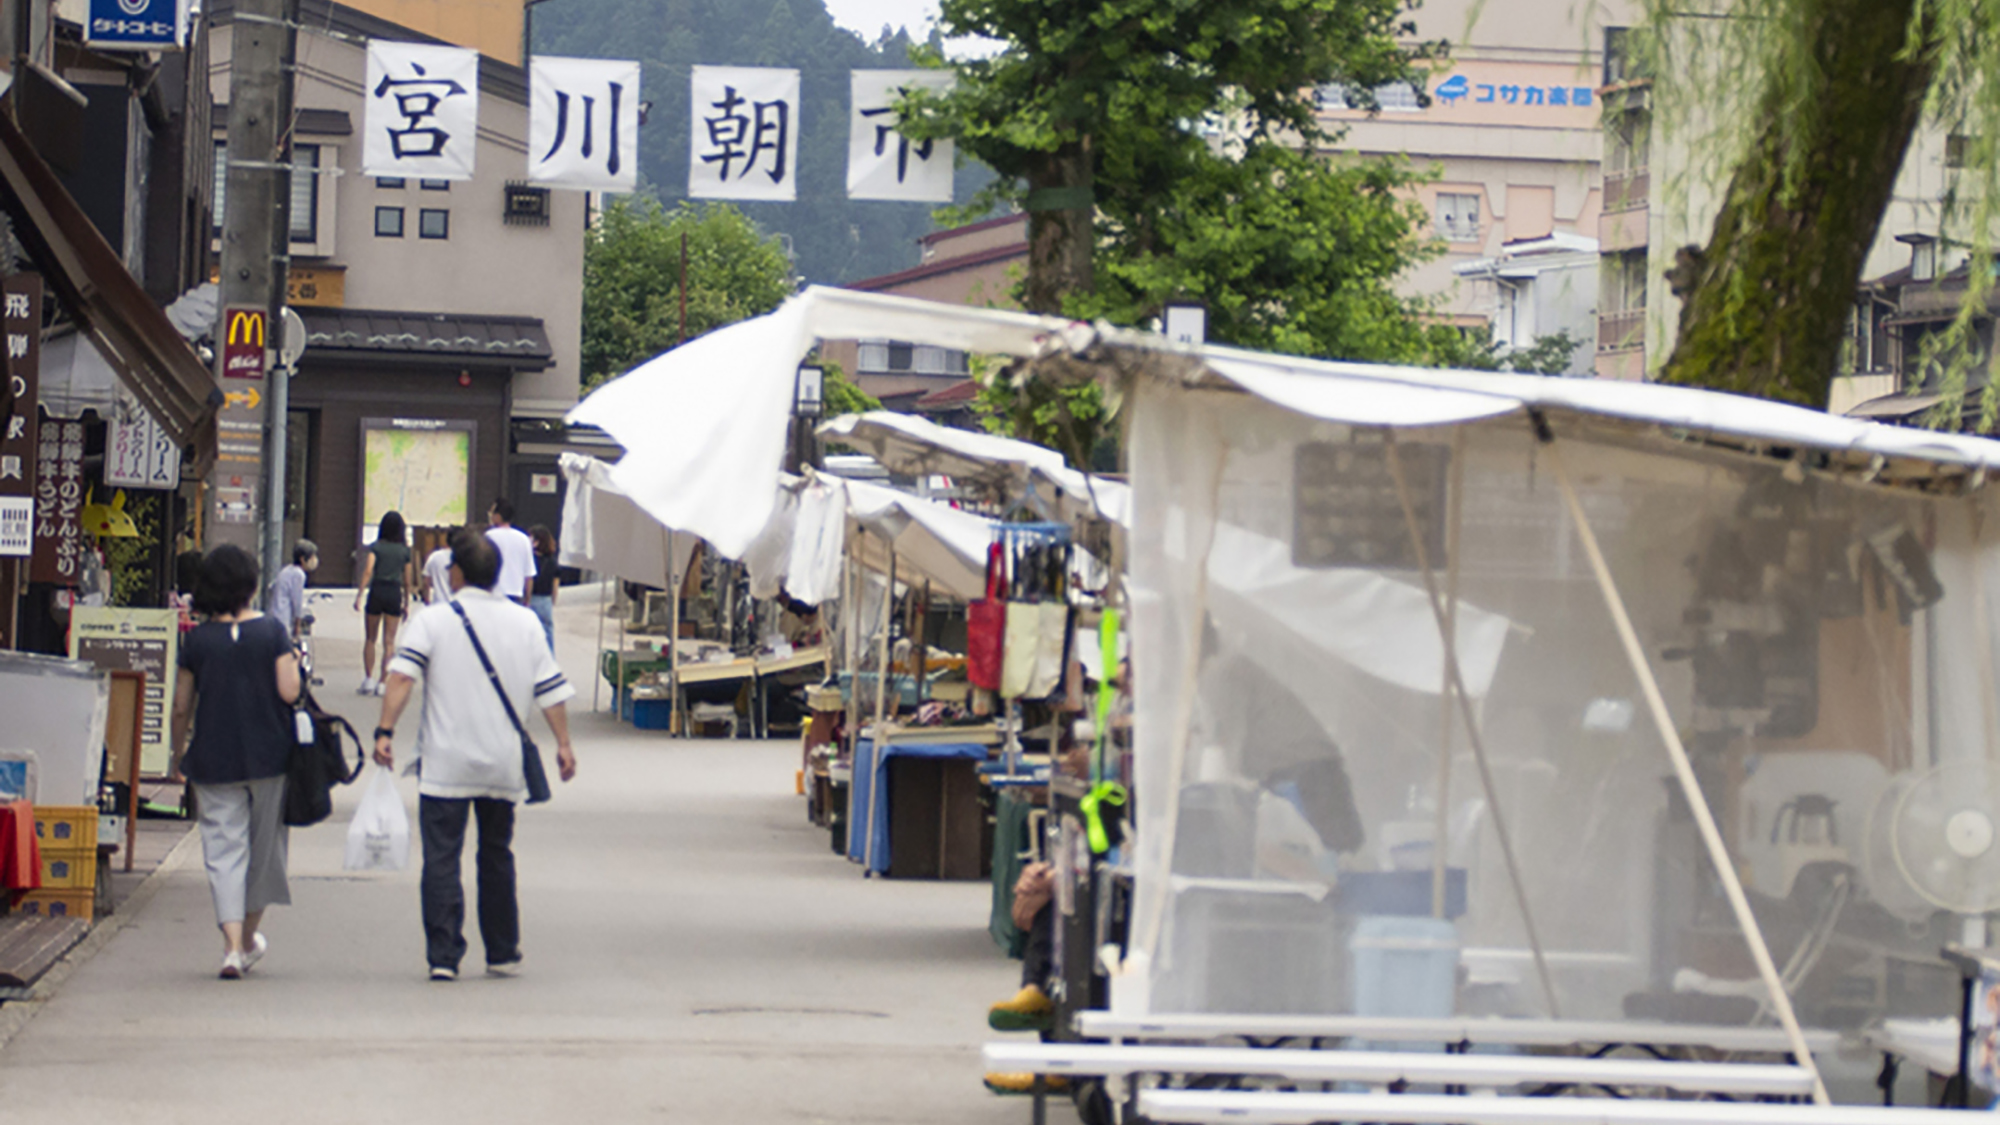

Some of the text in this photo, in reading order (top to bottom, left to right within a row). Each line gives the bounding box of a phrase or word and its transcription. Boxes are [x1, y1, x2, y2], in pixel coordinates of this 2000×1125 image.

[1476, 84, 1593, 106] コサカ楽器
